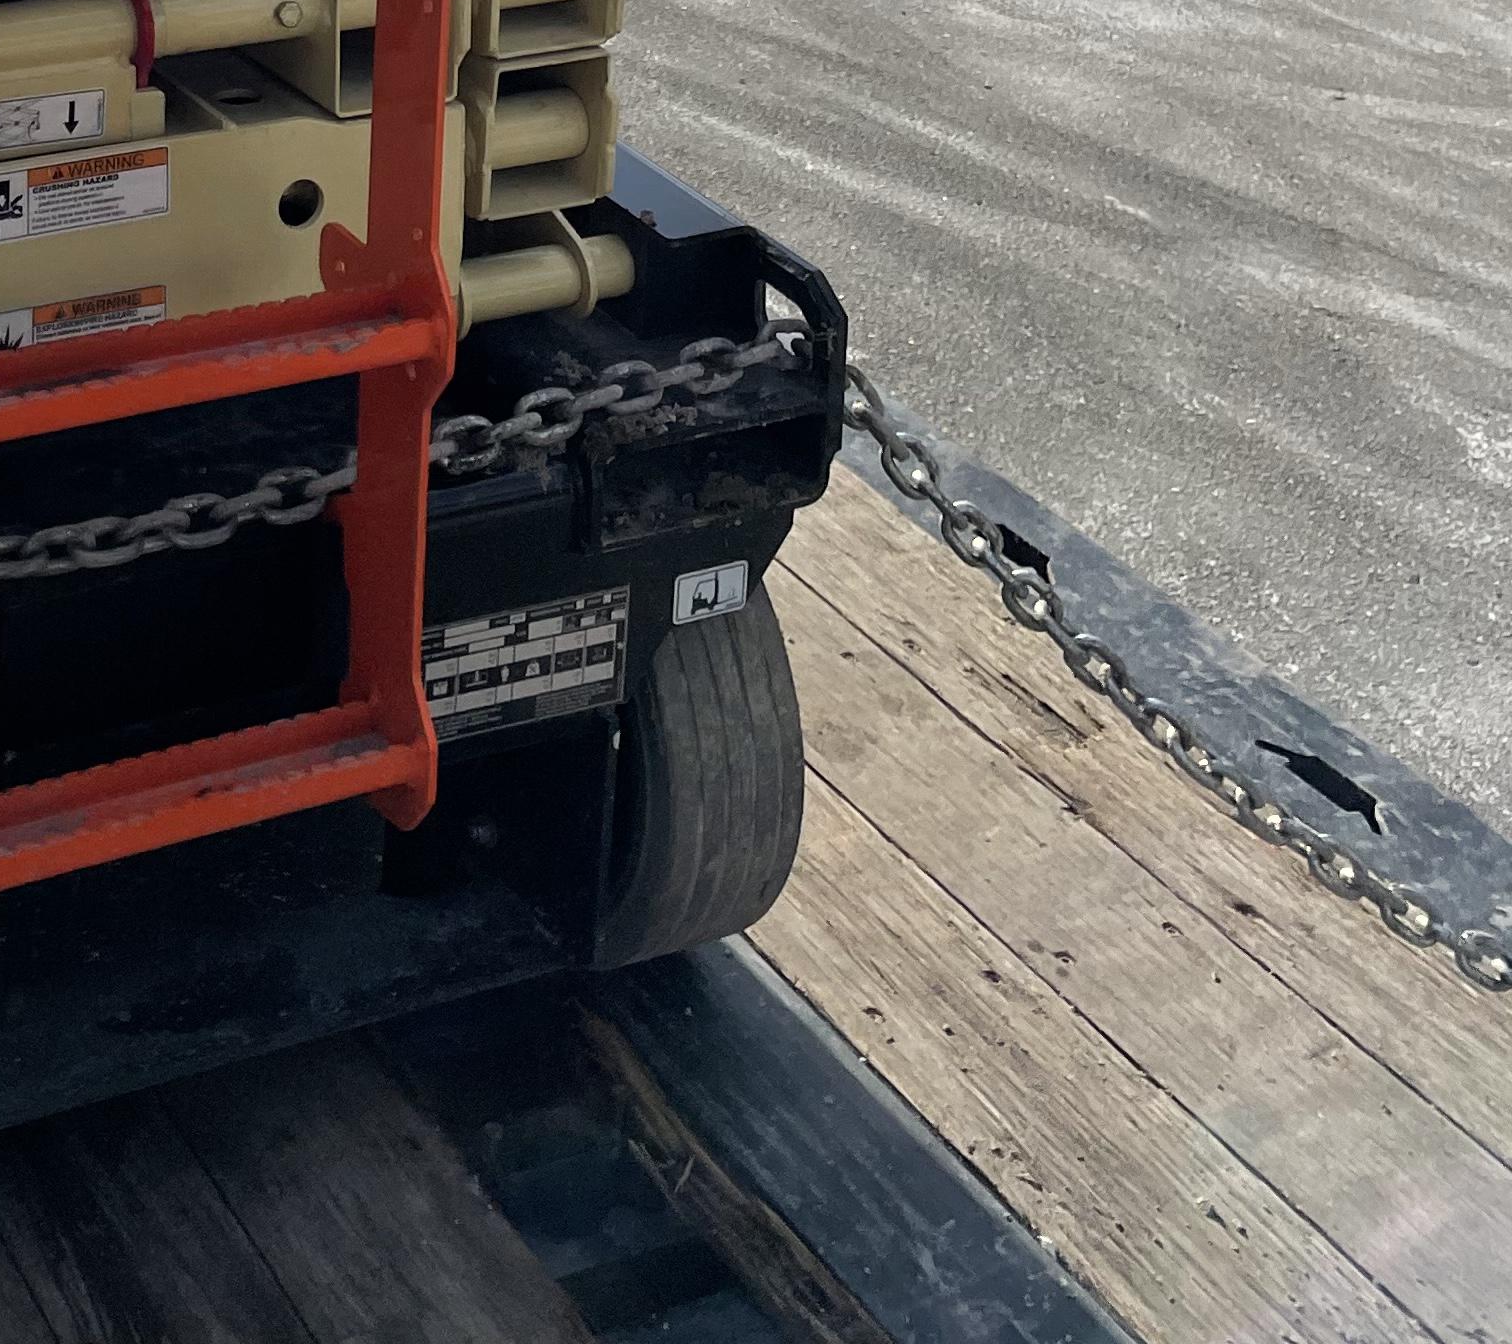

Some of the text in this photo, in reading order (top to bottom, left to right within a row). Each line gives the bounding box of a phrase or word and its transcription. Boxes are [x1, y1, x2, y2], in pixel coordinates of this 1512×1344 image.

[68, 153, 144, 178] WARNING
[32, 174, 119, 194] CRUSHING HAZARD
[72, 293, 142, 316] WARNING
